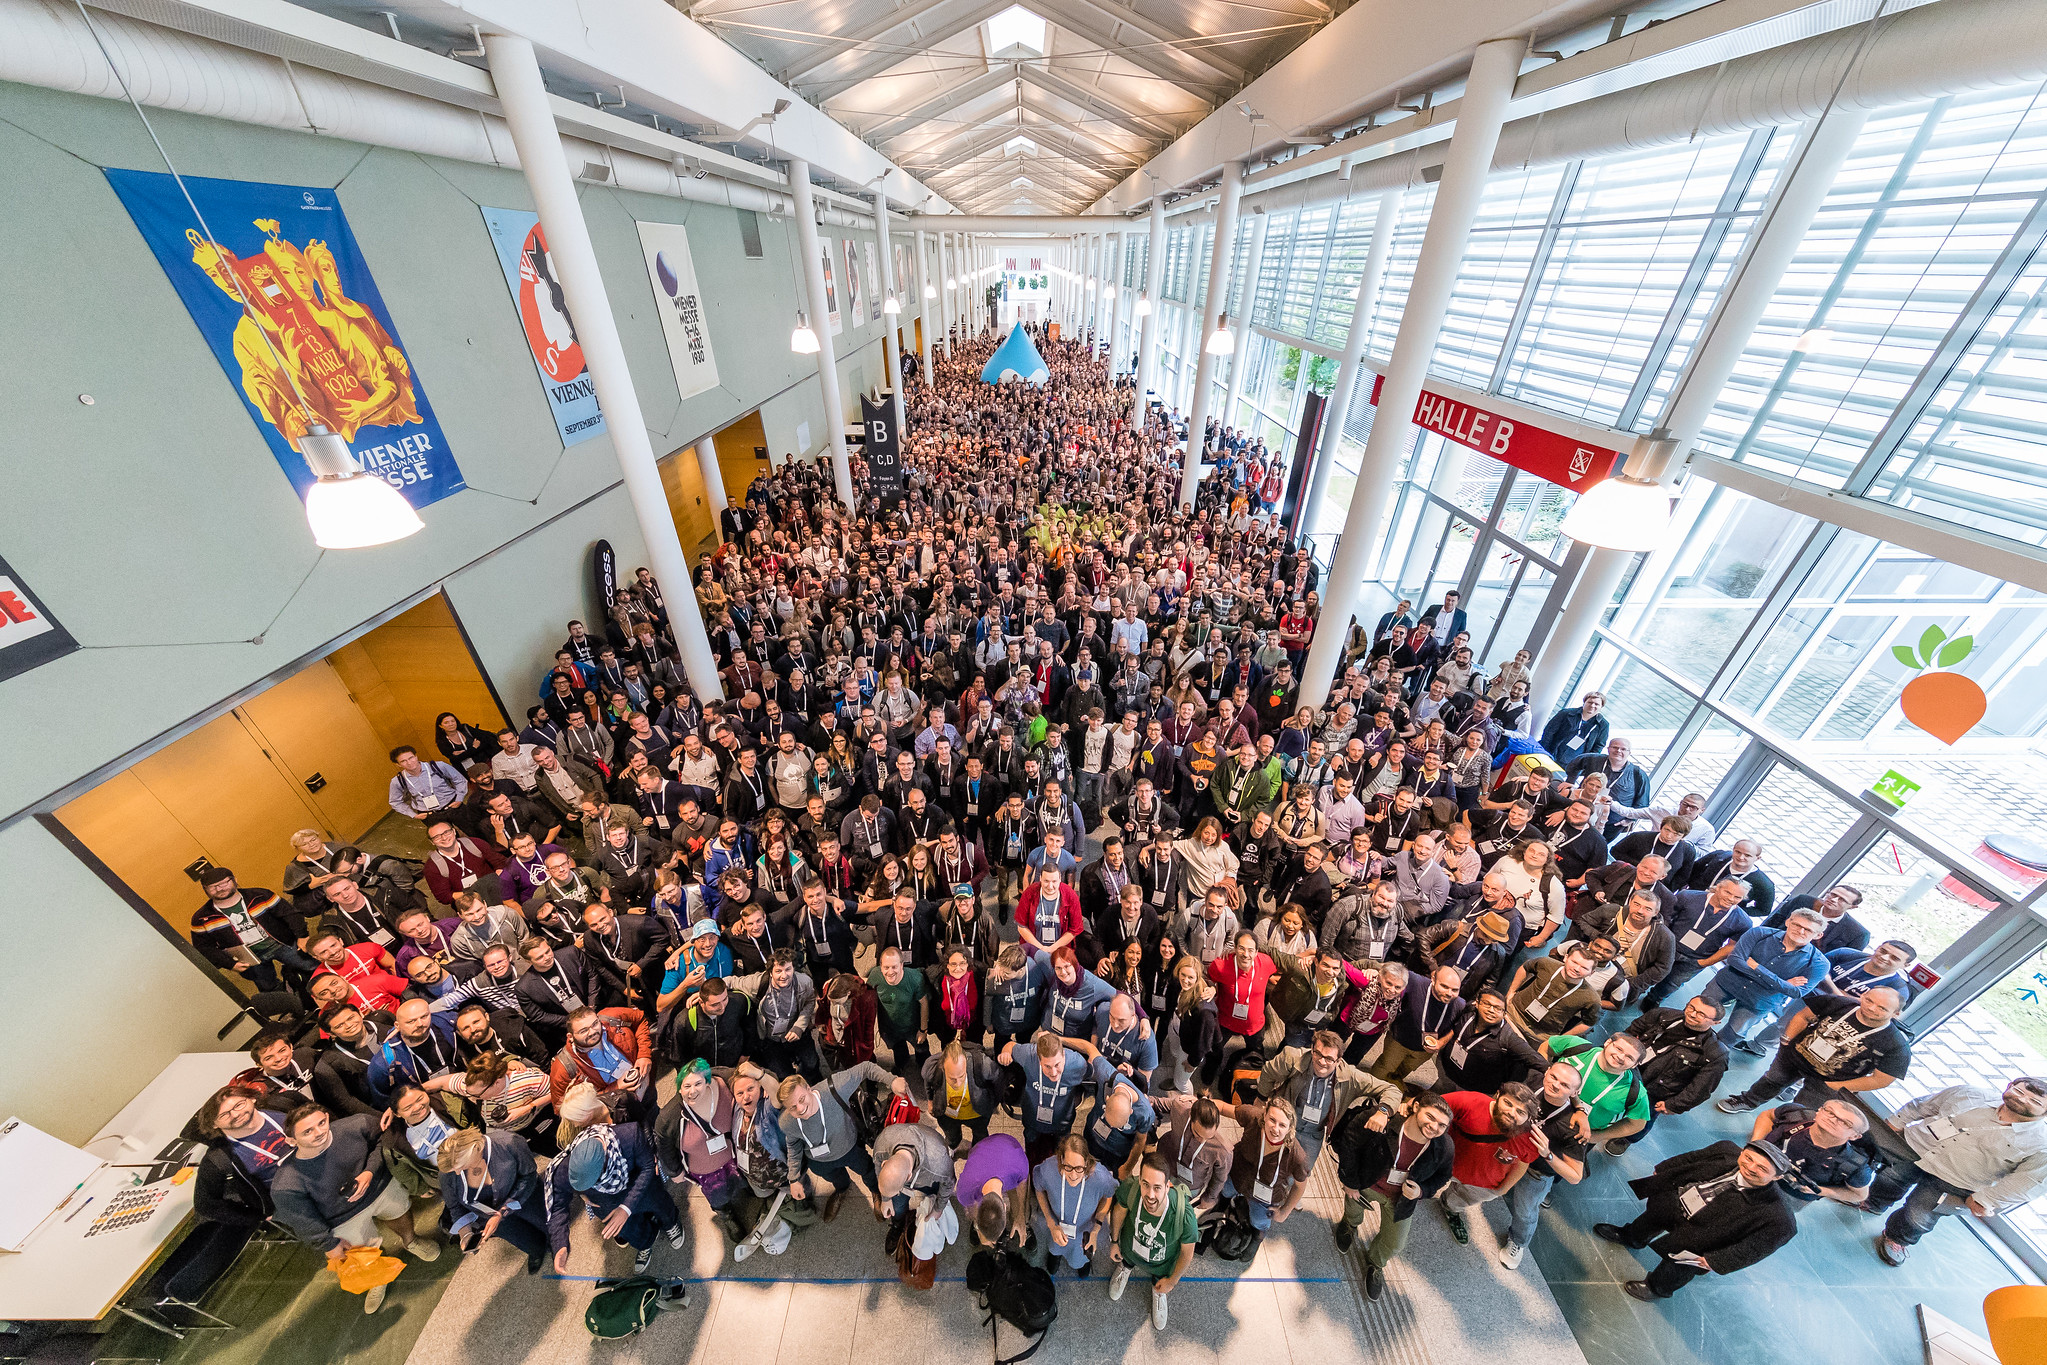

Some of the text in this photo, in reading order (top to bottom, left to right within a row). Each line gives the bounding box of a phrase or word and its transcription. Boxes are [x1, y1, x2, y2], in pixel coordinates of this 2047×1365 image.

[672, 295, 696, 311] WIENER
[285, 307, 306, 329] 7.
[679, 309, 699, 325] MESSE
[299, 327, 312, 336] bis
[304, 334, 326, 355] 13.
[306, 348, 345, 380] MÄRZ
[691, 350, 705, 365] 1930
[324, 369, 359, 399] 1926
[564, 417, 598, 435] SEPTEMBER
[872, 420, 888, 443] B
[1416, 393, 1515, 455] HALLE B
[363, 453, 426, 478] NATIONALE
[876, 454, 894, 466] C,D
[380, 461, 434, 490] SSE
[0, 590, 37, 628] E
